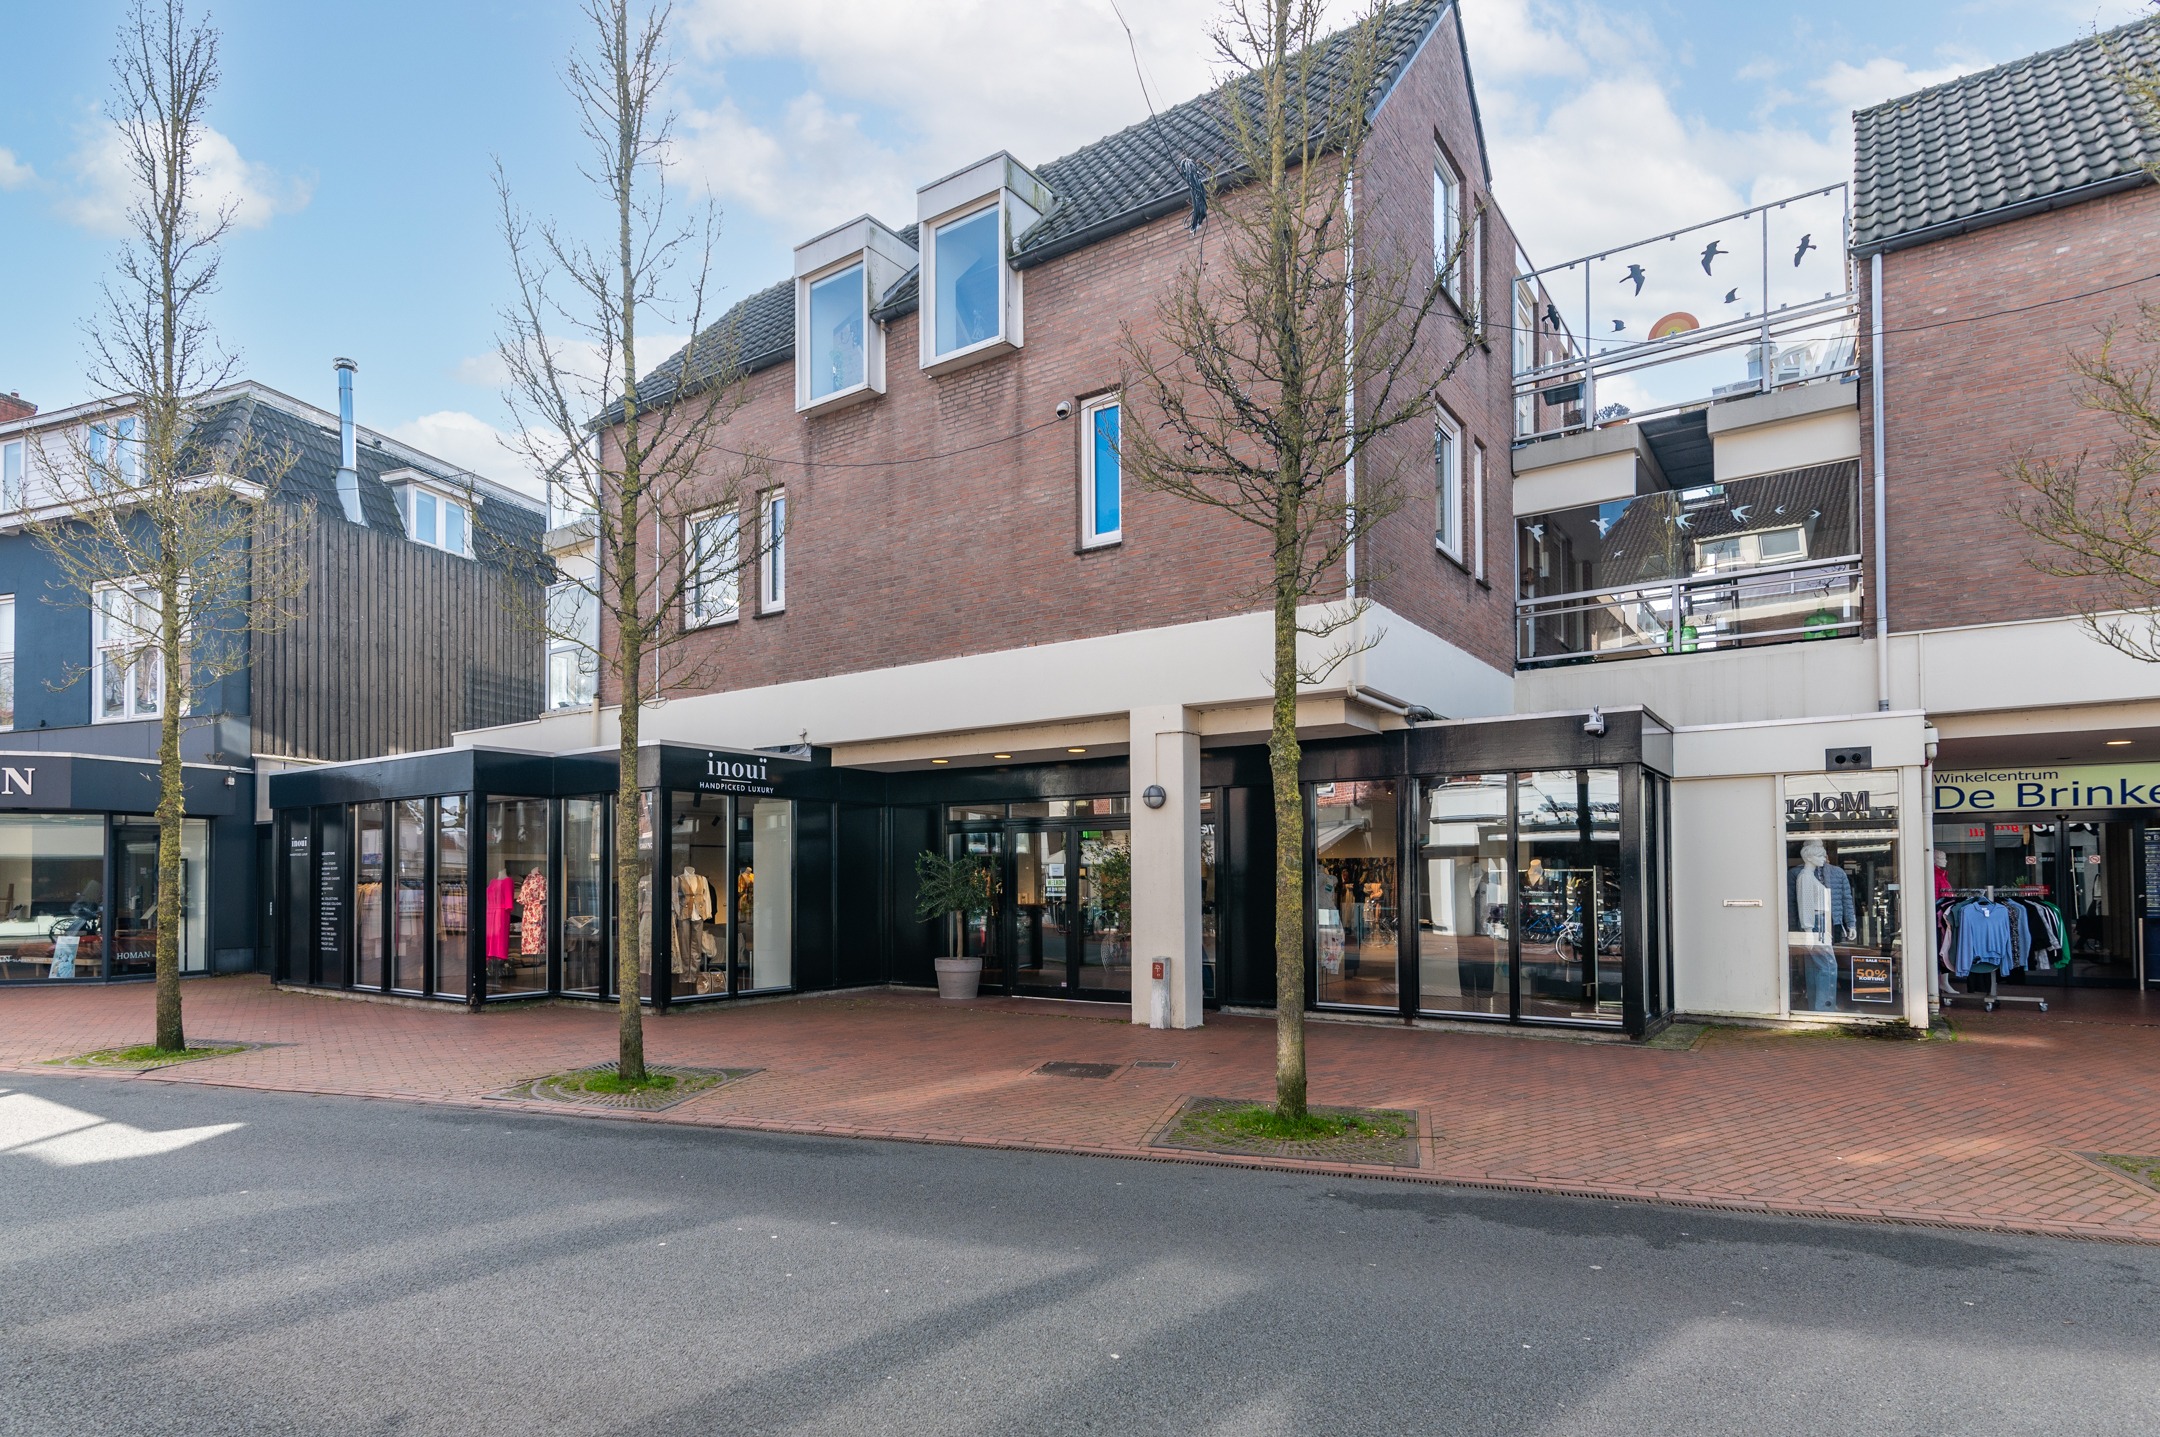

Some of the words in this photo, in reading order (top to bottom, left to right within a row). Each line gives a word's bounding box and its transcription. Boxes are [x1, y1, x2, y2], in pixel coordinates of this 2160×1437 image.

[707, 752, 767, 780] inouï
[1933, 771, 2059, 784] Winkelcentrum
[699, 781, 746, 792] HANDPICKED
[748, 785, 774, 794] LUXURY
[1934, 785, 1995, 810] De
[116, 950, 151, 960] HOMAN
[1856, 968, 1888, 979] 50%
